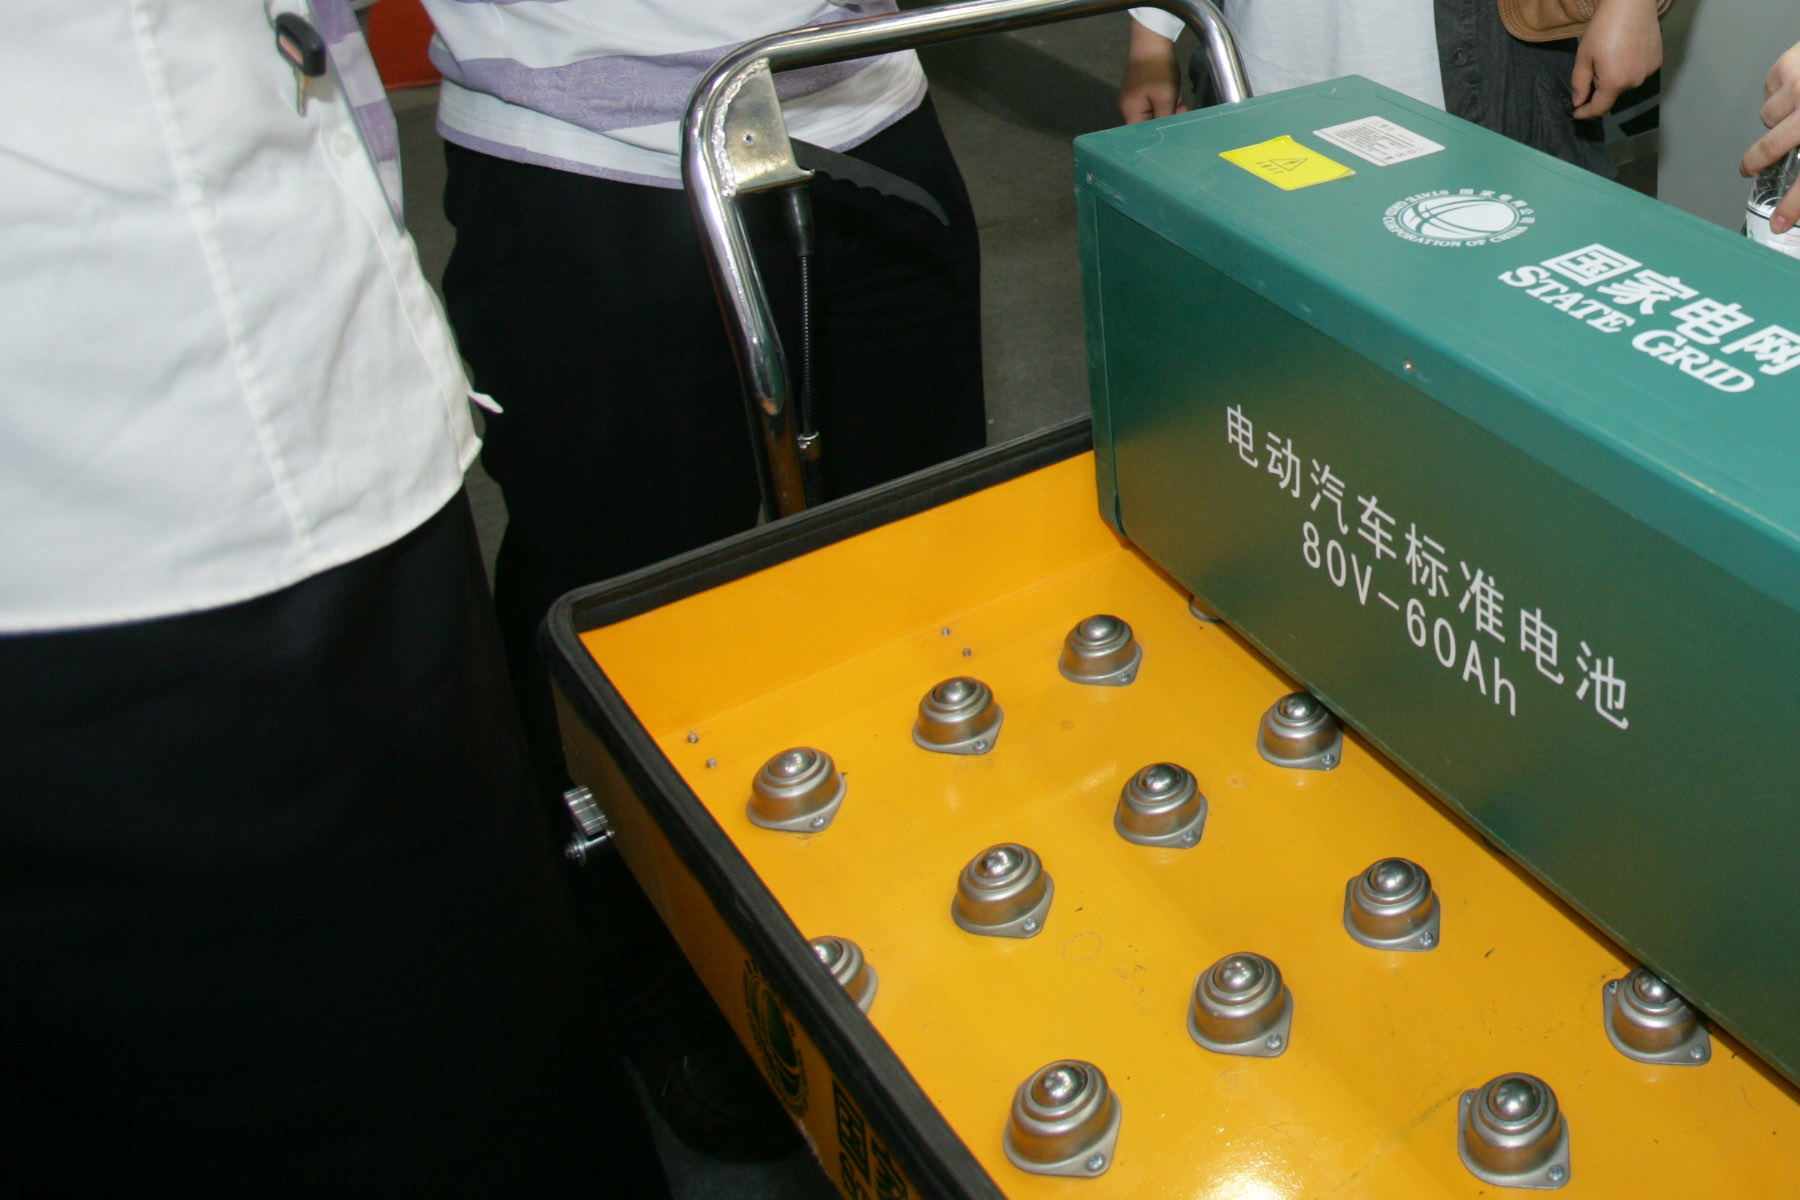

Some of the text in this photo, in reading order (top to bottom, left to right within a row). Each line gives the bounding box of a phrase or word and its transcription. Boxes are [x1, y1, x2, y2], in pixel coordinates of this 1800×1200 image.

[1498, 264, 1755, 393] STATE GRID
[1226, 404, 1629, 730] 电动汽车标准电池
[1302, 521, 1517, 717] 80V-60Ah
